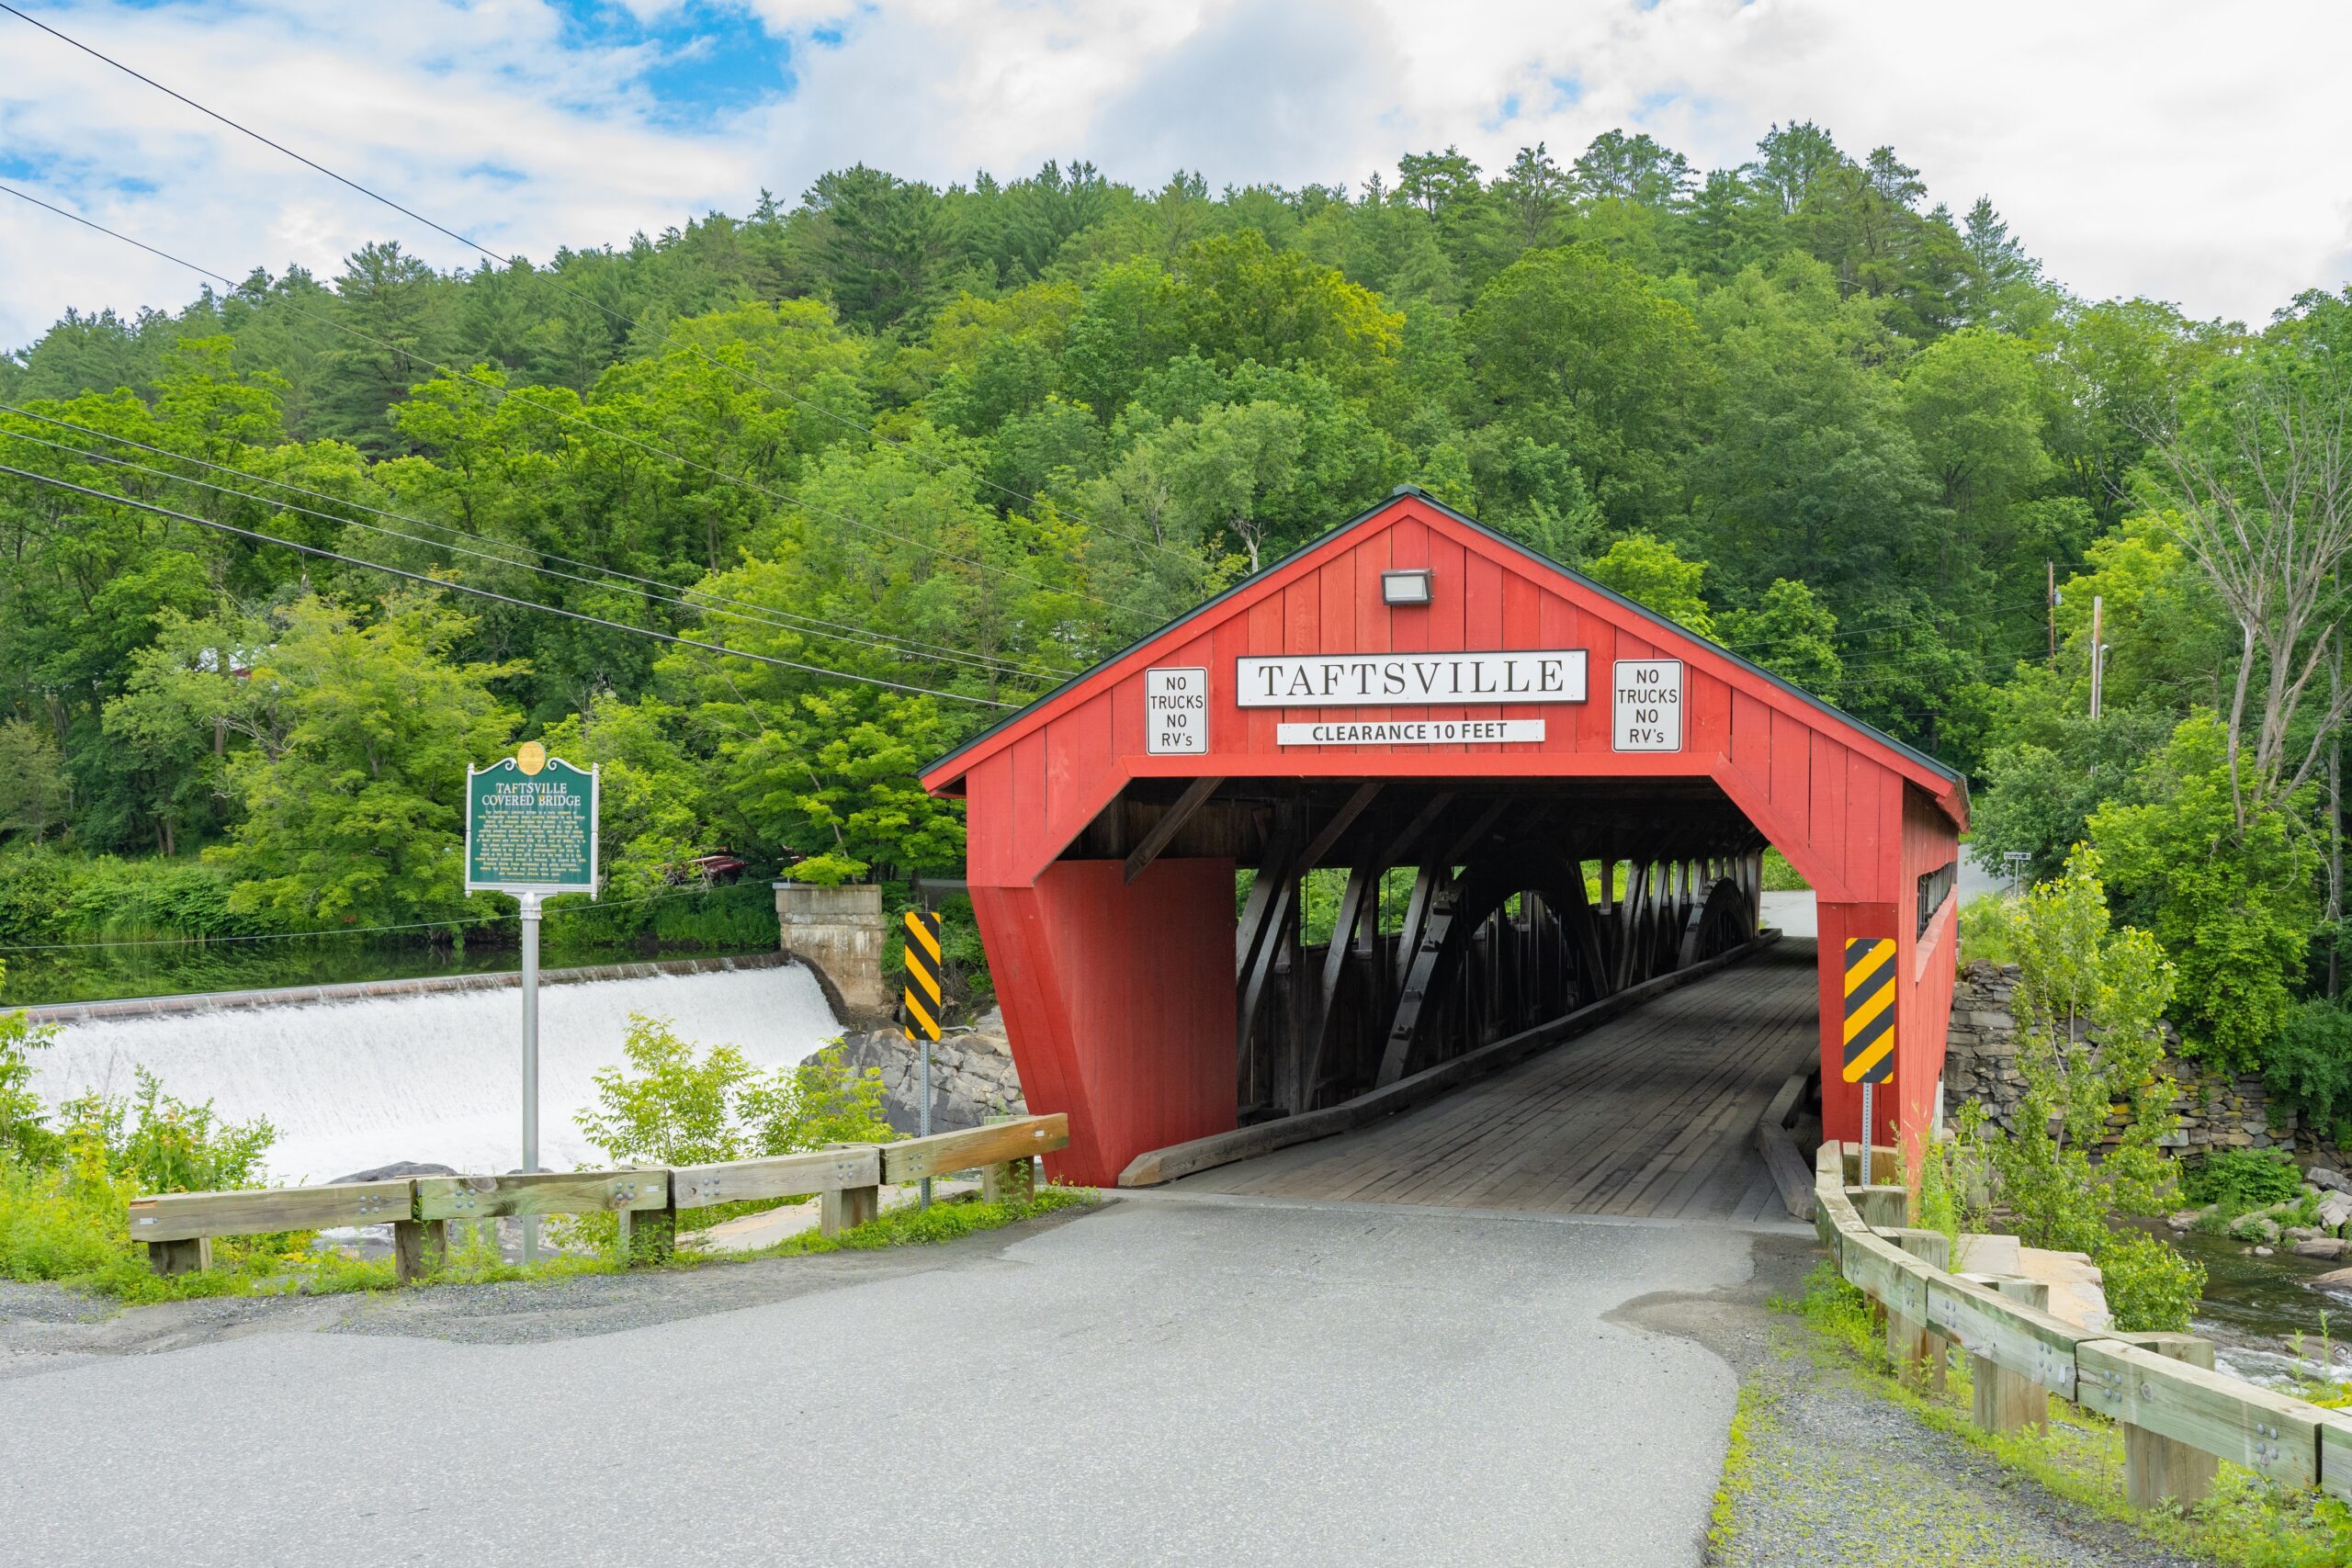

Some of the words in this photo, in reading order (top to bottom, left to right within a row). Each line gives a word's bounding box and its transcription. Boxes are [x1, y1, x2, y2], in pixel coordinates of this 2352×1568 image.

[1167, 677, 1186, 691] NO
[1258, 660, 1564, 696] TAFTSVILLE
[1636, 669, 1659, 684] NO
[1150, 694, 1204, 710] TRUCKS
[1618, 689, 1678, 704] TRUCKS
[1167, 714, 1187, 728] NO
[1636, 708, 1658, 724] NO
[1161, 732, 1193, 747] RV's
[1312, 724, 1426, 742] CLEARANCE
[1433, 724, 1455, 739] 10
[1461, 722, 1508, 739] FEET
[1629, 728, 1664, 743] RV's
[495, 783, 568, 795] TAFTSVILLE
[482, 795, 535, 807] COVERED
[538, 795, 582, 807] BRIDGE
